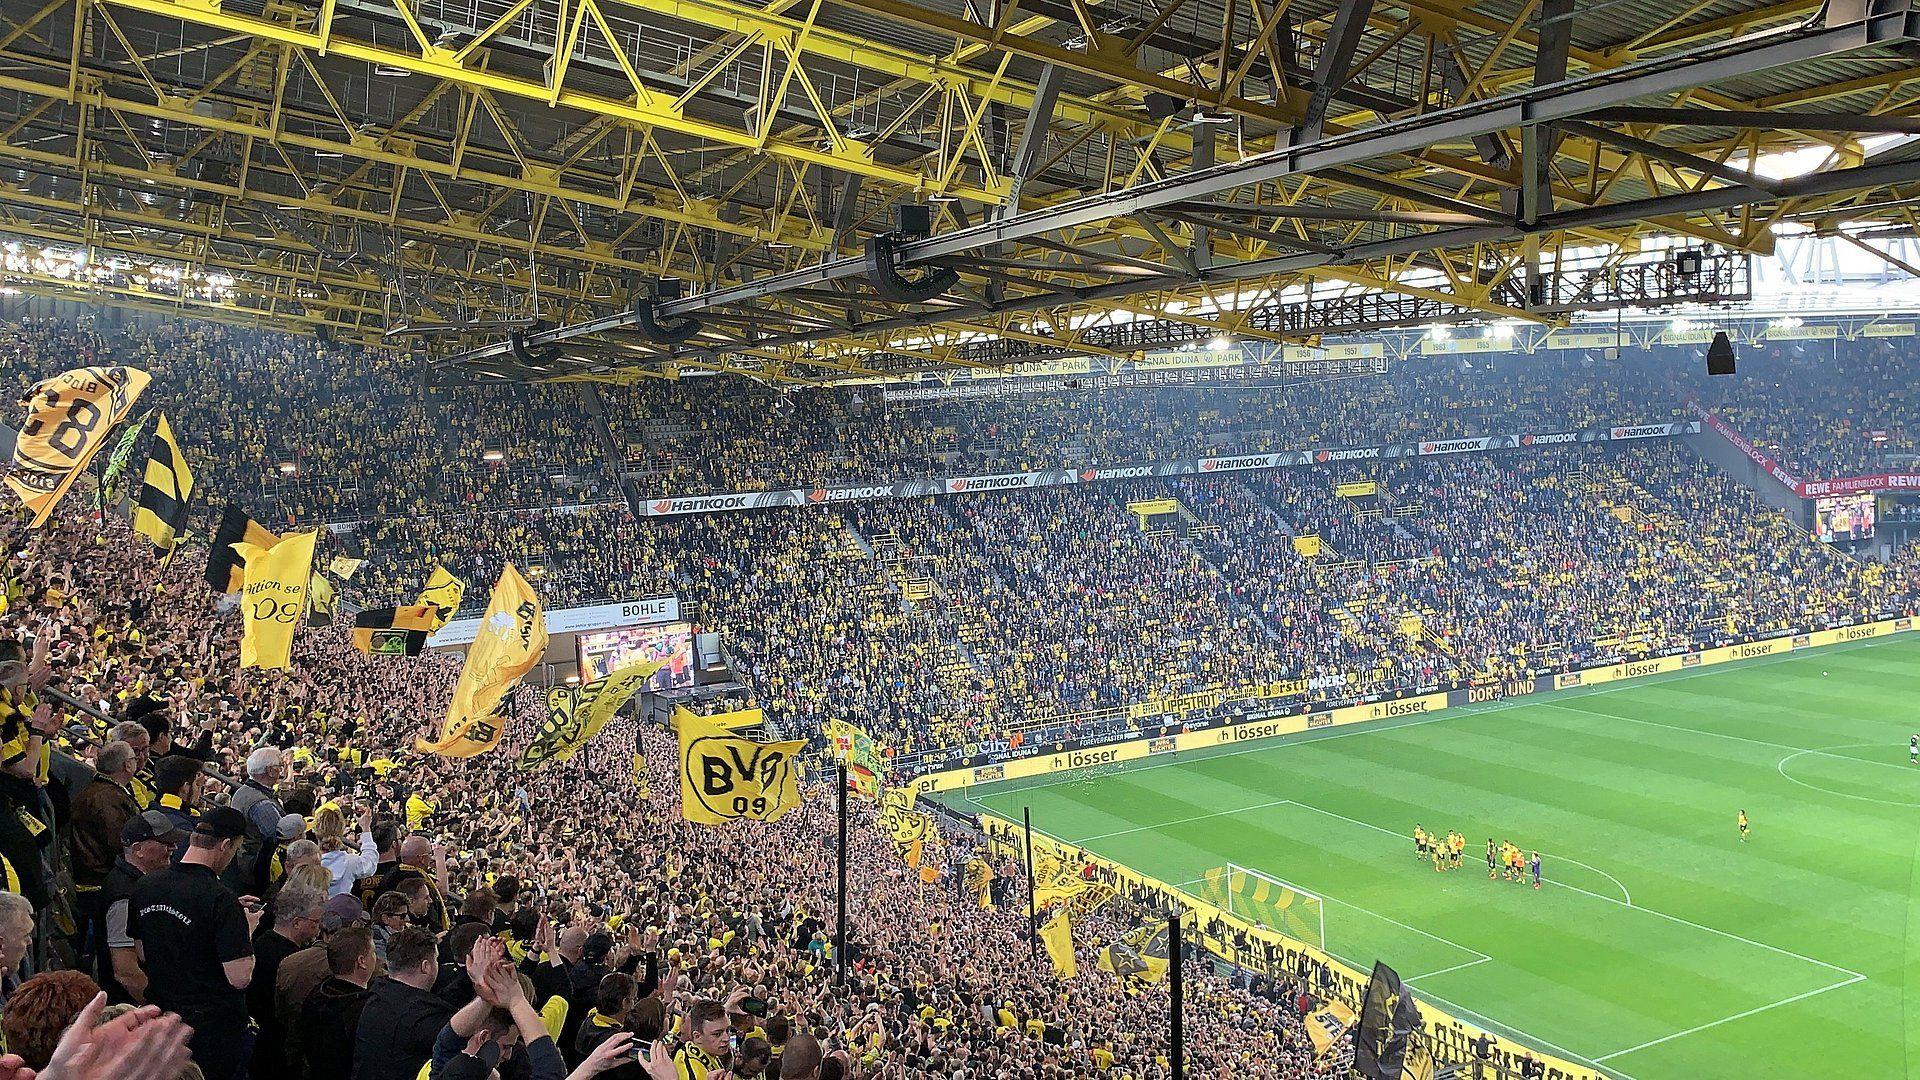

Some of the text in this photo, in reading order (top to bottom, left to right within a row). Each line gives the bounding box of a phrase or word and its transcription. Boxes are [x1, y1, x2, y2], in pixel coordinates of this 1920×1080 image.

[1663, 333, 1686, 342] SIGNAL
[1768, 330, 1790, 339] SIGNAL
[1820, 327, 1836, 336] PARK
[1172, 357, 1200, 365] IDUNA
[1217, 353, 1240, 363] PARK
[1296, 350, 1311, 358] 1956
[1344, 348, 1357, 356] 1957
[974, 360, 1088, 376] SIGN DUNA PARK
[1531, 431, 1578, 444] HANKOOK
[1623, 424, 1666, 436] HANKOOK
[1431, 440, 1482, 453] HANKOOK
[1715, 421, 1769, 468] FAMILIENBLOCK
[1327, 447, 1380, 461] HANKOOK
[1215, 455, 1270, 471] HANKOOK
[1093, 464, 1154, 480] HANKOOK
[1771, 466, 1799, 491] REWE
[966, 474, 1028, 490] HANKOOK
[1805, 482, 1831, 495] REWE
[1832, 477, 1884, 491] FAMILIENBLOCK
[825, 484, 894, 501] HANKOOK
[671, 496, 746, 512] HANKOOK
[623, 602, 666, 618] BOHLE
[1847, 625, 1876, 639] lösser
[1741, 643, 1772, 657] lösser
[1626, 662, 1660, 677] lösser
[1309, 674, 1347, 690] MOERS
[1468, 681, 1535, 703] DORTUND
[1162, 693, 1216, 713] LIPPSTADT
[1385, 699, 1427, 716] lösser
[1234, 722, 1279, 741] lösser
[1080, 736, 1103, 747] FOREVER
[1103, 733, 1123, 743] FASTER
[1068, 748, 1118, 768] lösser
[732, 796, 767, 815] 09
[901, 829, 914, 839] 09
